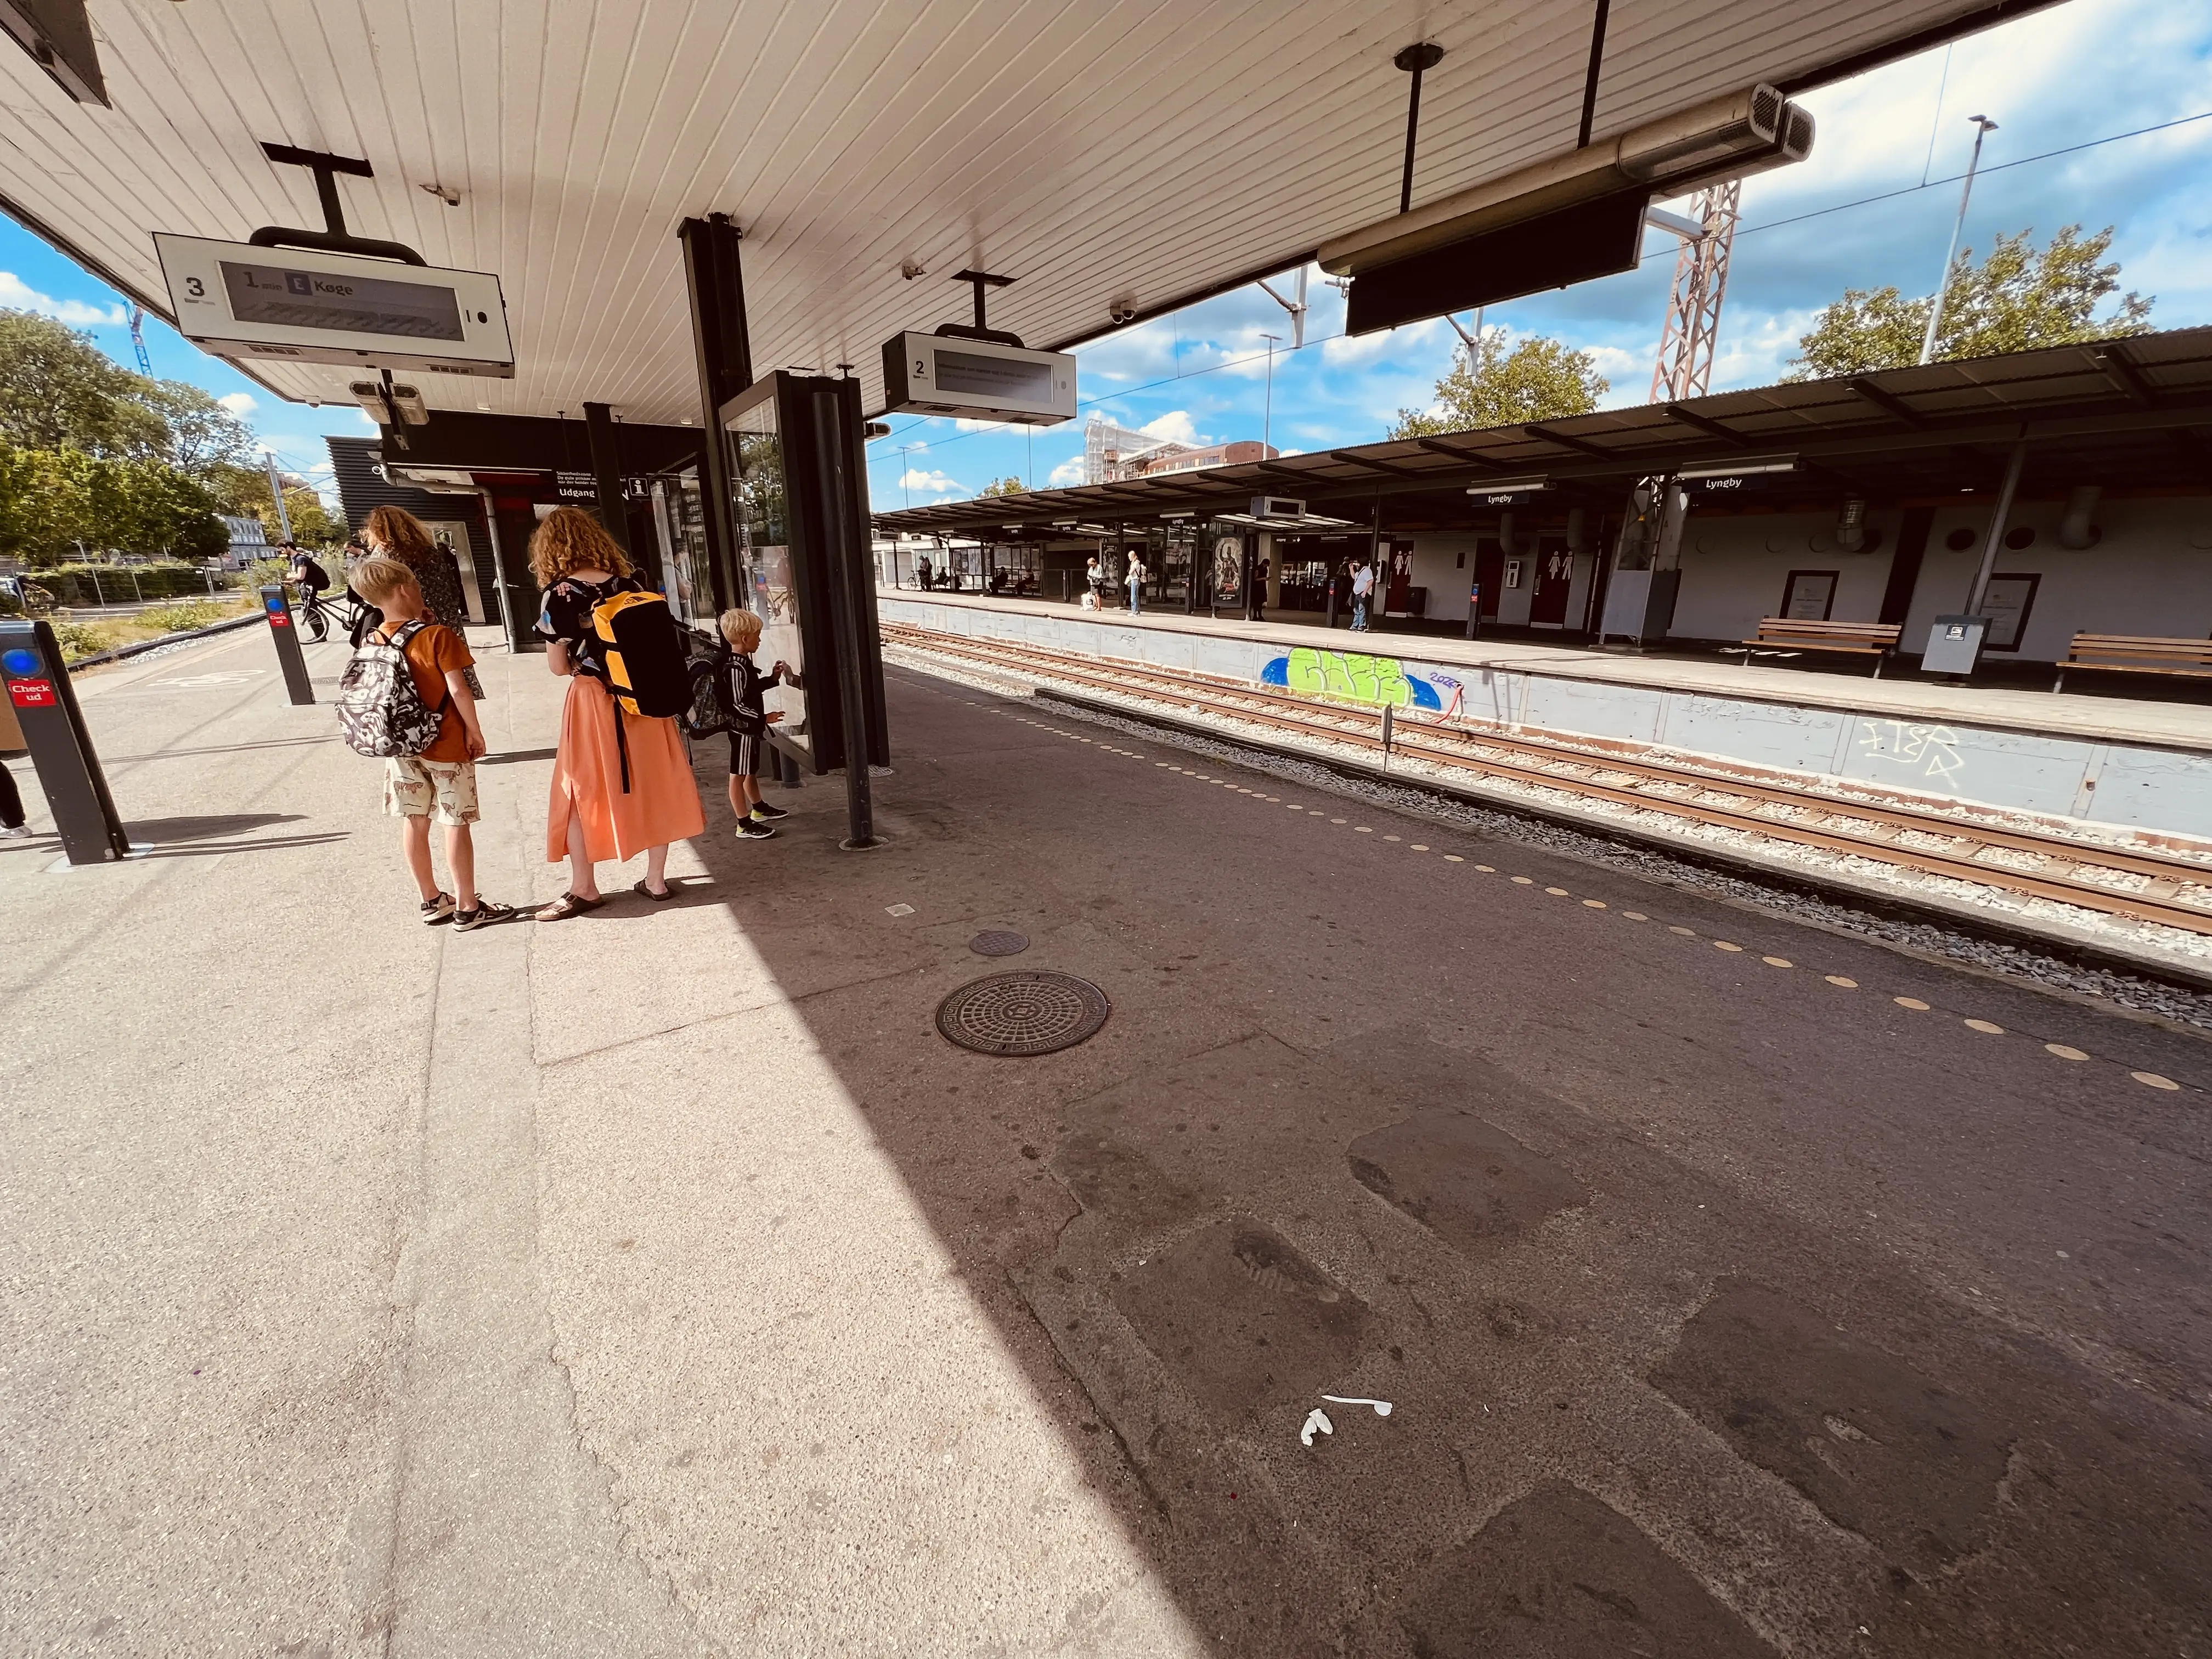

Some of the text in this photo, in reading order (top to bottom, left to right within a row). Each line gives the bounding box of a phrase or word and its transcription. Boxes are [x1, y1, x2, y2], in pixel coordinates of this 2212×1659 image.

[186, 277, 205, 296] 3
[243, 271, 259, 288] 1
[314, 280, 353, 296] Køge
[915, 360, 924, 374] 2
[1706, 477, 1742, 490] Lyngby
[559, 488, 595, 498] Udgang
[1488, 494, 1513, 504] Lyngby
[12, 684, 50, 693] Check
